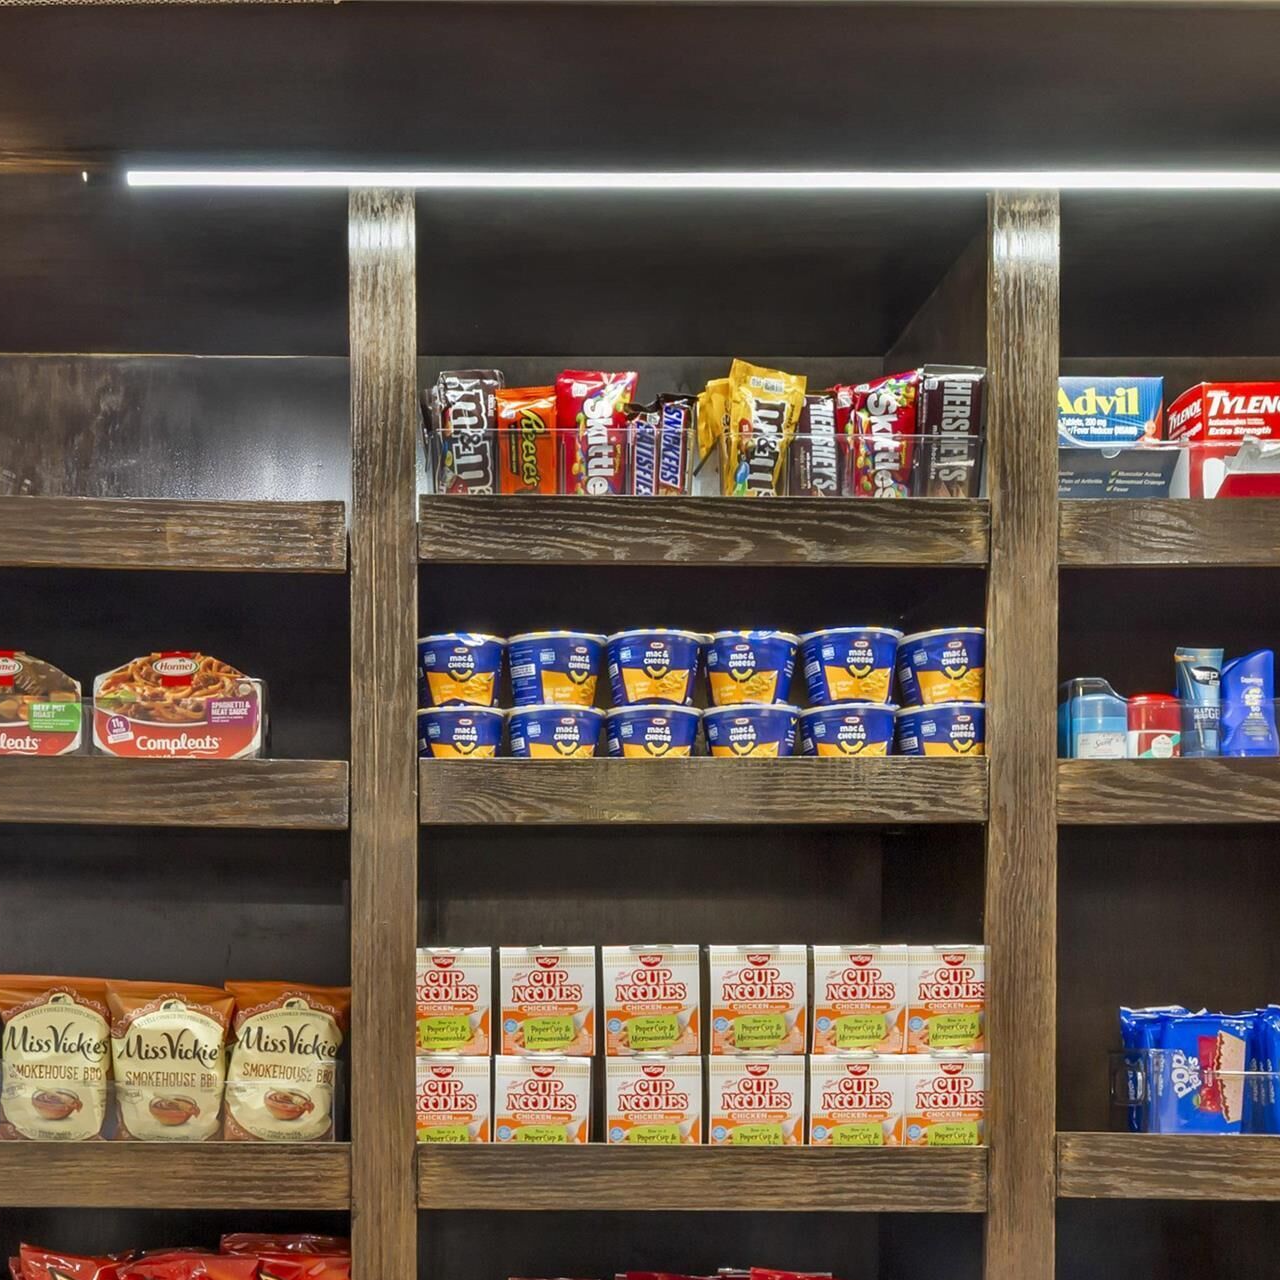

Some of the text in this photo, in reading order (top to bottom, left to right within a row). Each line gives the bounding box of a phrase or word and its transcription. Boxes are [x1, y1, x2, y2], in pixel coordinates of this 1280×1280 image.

[1058, 386, 1140, 416] Advil
[938, 381, 973, 481] HERSHEY'S
[520, 408, 545, 487] Reese's
[159, 660, 194, 672] Hormel
[136, 733, 219, 754] Compleats
[528, 969, 568, 987] CUP
[631, 969, 672, 986] CUP
[739, 968, 780, 985] CUP
[842, 968, 882, 985] CUP
[935, 968, 975, 985] CUP
[511, 984, 583, 1003] NOODLES
[615, 983, 687, 1002] NOODLES
[722, 982, 795, 1001] NOODLES
[826, 982, 896, 1001] NOODLES
[919, 982, 985, 1001] NOODLES
[4, 1025, 48, 1053] Miss
[117, 1028, 219, 1067] Miss Vickie'
[238, 1023, 339, 1060] Miss Vickie'
[8, 1064, 79, 1081] SMOKEHOUSE
[125, 1071, 196, 1088] SMOKEHOUSE
[523, 1079, 564, 1096] CUP
[634, 1079, 675, 1096] CUP
[738, 1078, 778, 1094] CUP
[507, 1093, 577, 1112] NOODLES
[618, 1093, 689, 1112] NOODLES
[721, 1092, 792, 1110] NOODLES
